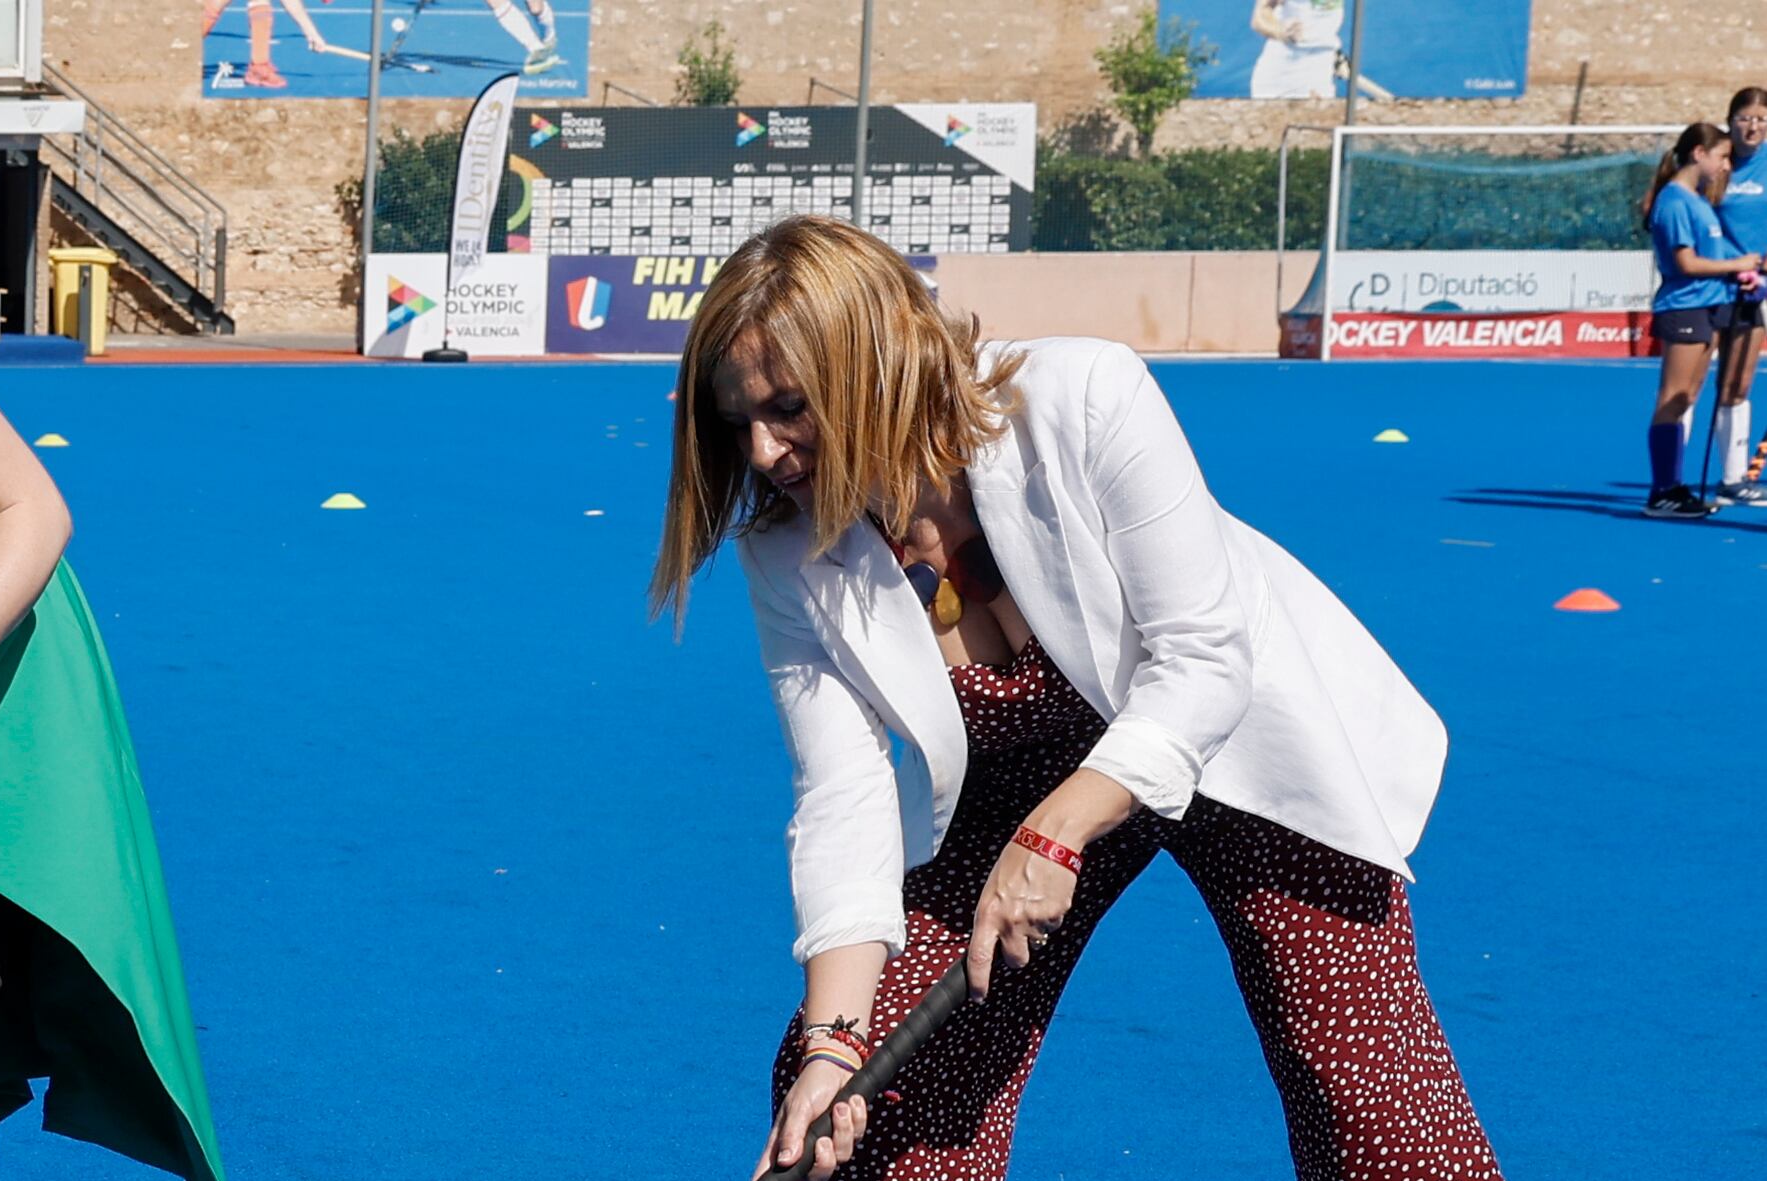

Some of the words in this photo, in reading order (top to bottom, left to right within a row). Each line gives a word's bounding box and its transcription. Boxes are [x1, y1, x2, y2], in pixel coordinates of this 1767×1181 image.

[633, 257, 696, 285] FIH
[1418, 272, 1539, 302] Diputació
[446, 300, 525, 315] OLYMPIC
[456, 326, 521, 337] VALENCIA
[1328, 321, 1417, 349] OCKEY
[1423, 320, 1564, 347] VALENCIA
